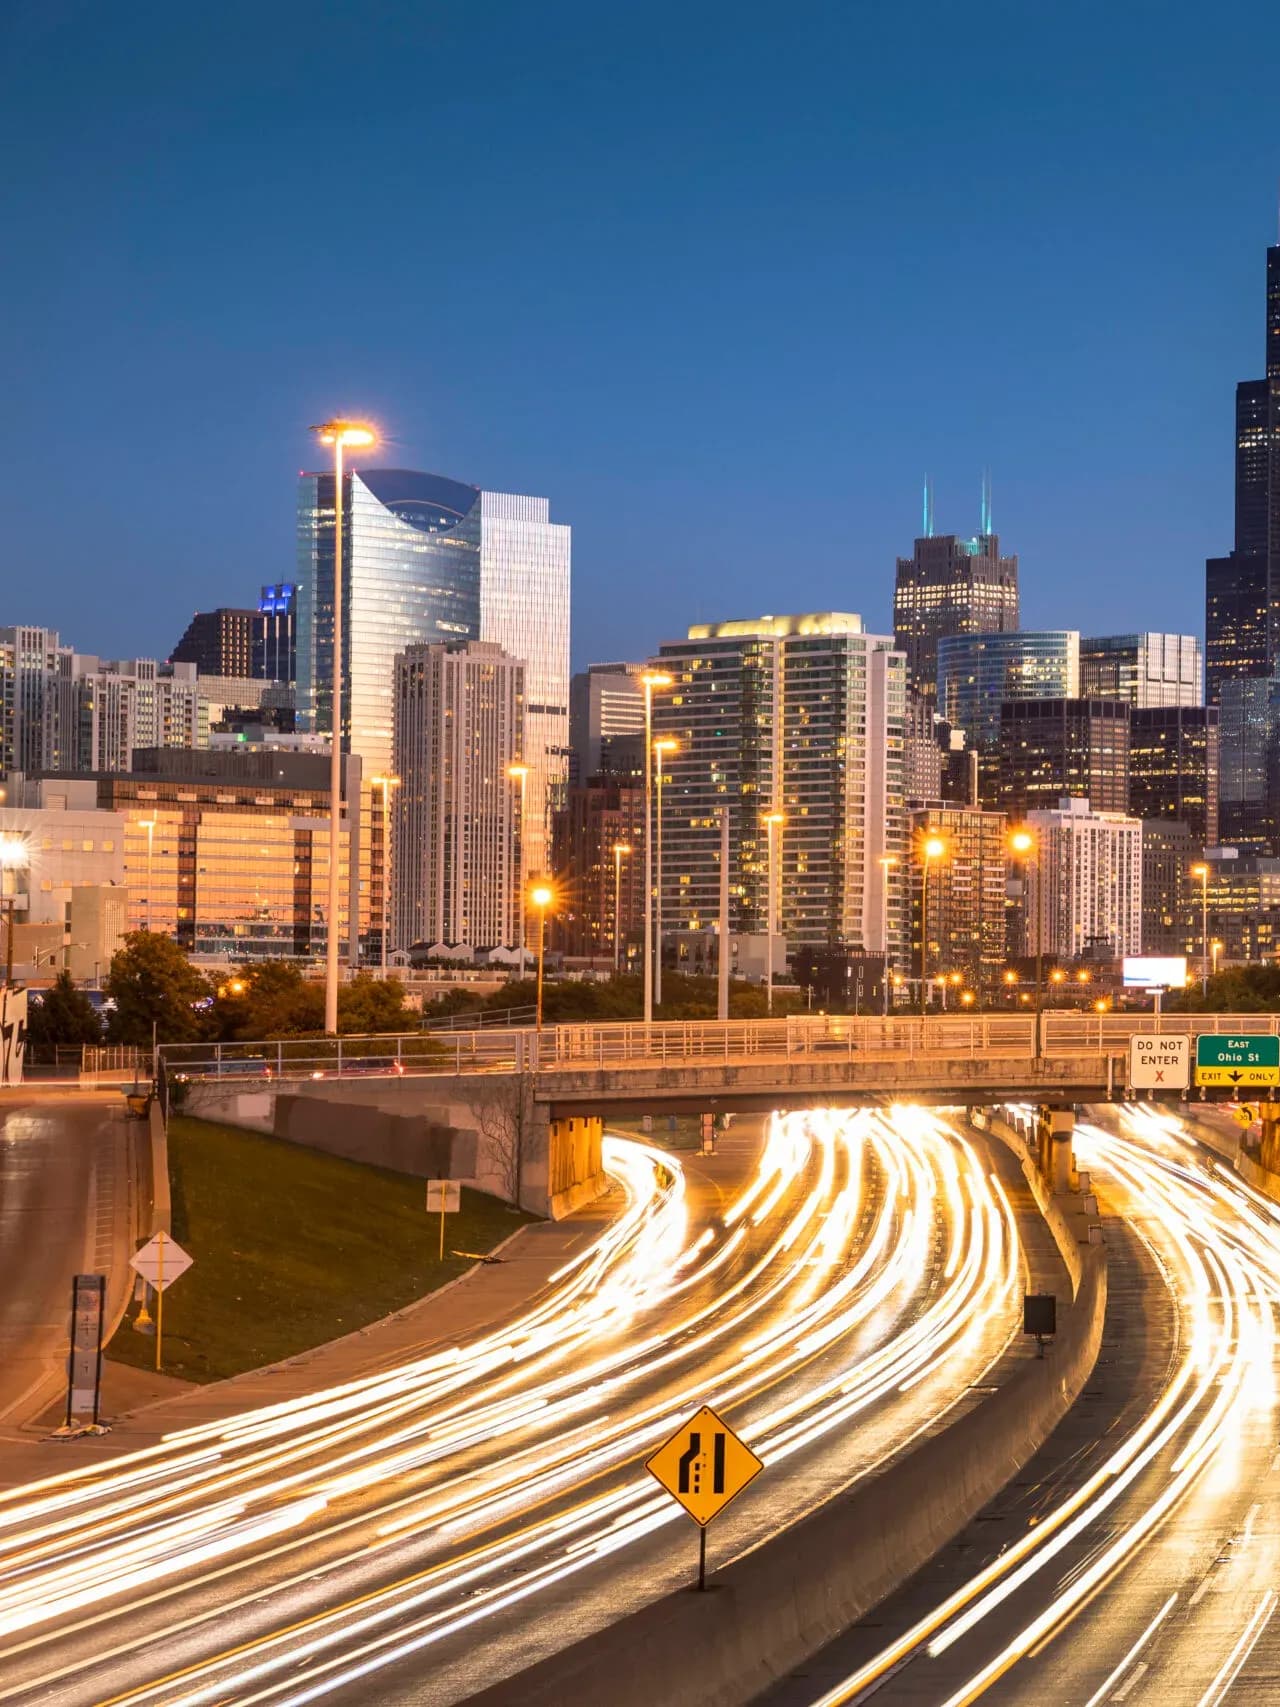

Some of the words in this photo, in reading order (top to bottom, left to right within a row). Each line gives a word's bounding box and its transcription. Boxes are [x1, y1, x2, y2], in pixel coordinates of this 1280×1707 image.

[1137, 1041, 1153, 1050] DO
[1160, 1041, 1183, 1050] NOT
[1227, 1040, 1250, 1048] EAST
[1141, 1056, 1179, 1065] ENTER
[1217, 1053, 1243, 1062] Ohio
[1248, 1053, 1260, 1062] St
[1201, 1072, 1222, 1080] EXIT
[1249, 1072, 1275, 1081] ONLY
